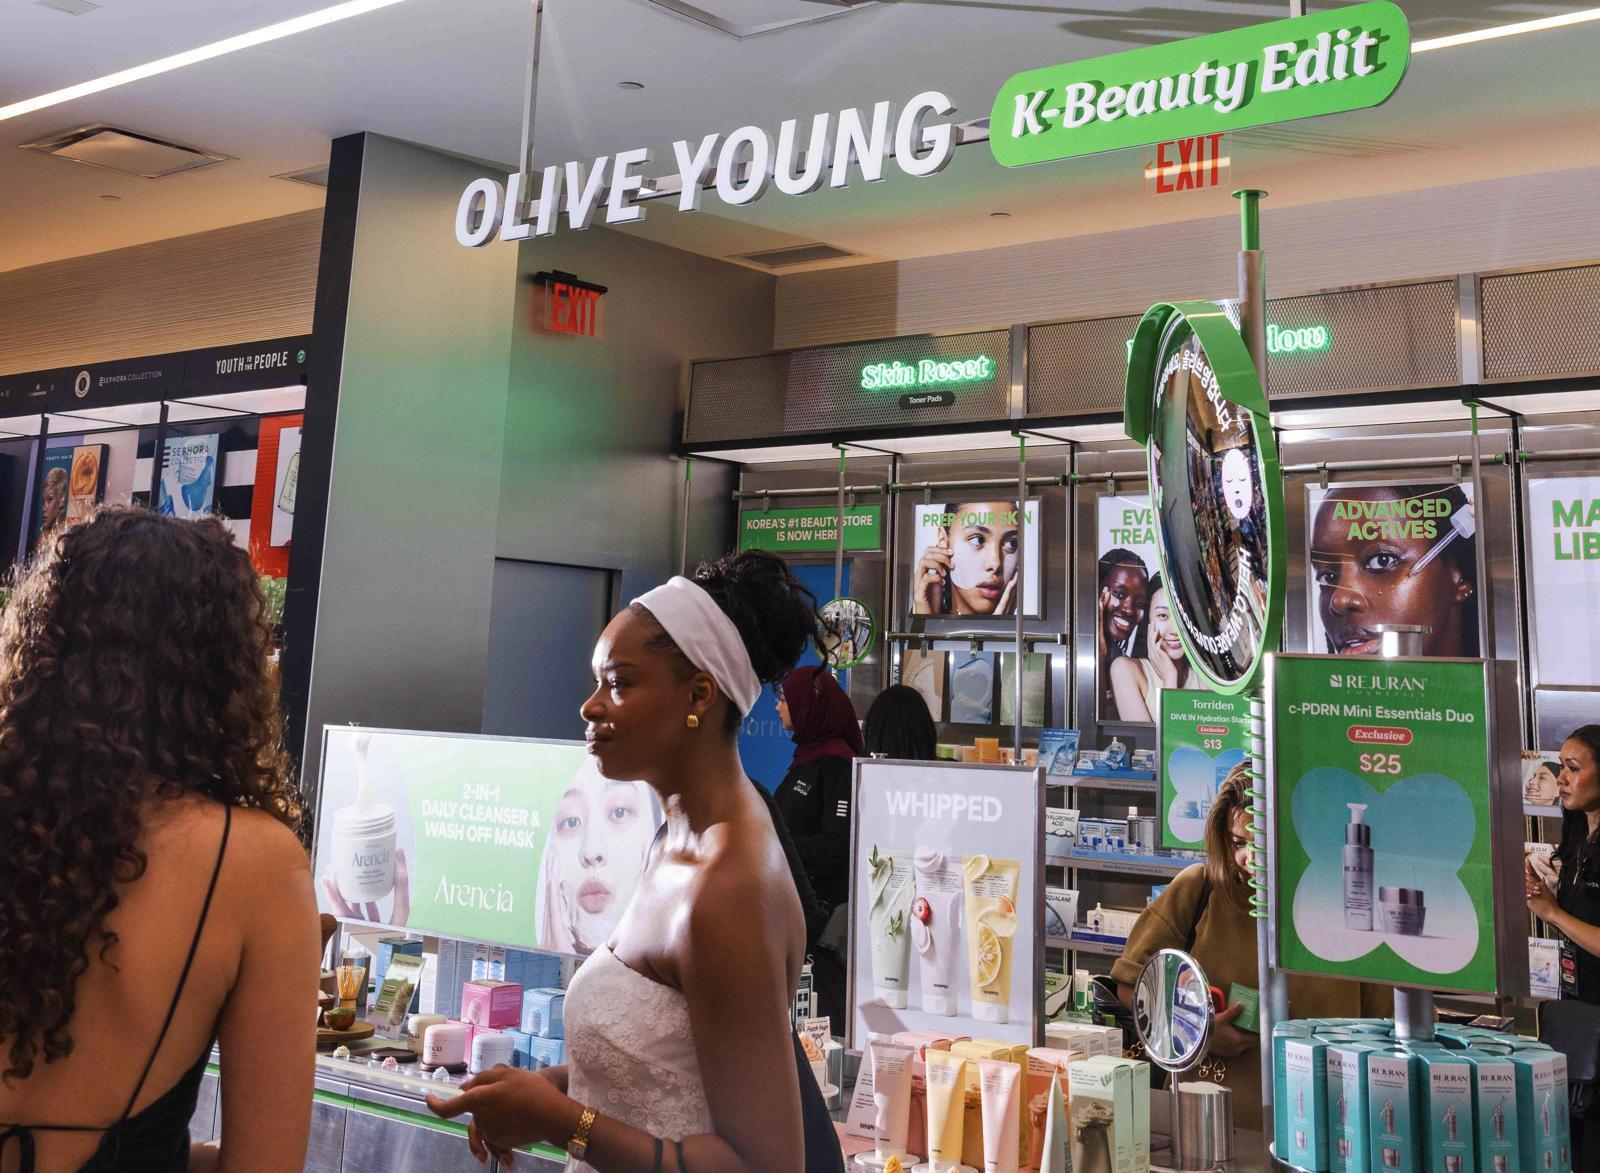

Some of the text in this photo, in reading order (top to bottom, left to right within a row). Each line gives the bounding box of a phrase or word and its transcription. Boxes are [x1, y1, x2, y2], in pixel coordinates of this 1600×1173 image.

[1011, 28, 1379, 138] K-Beauty Edit
[455, 90, 958, 248] OLIVE YOUNG
[1156, 133, 1225, 194] EXIT
[551, 282, 601, 337] EXIT
[1265, 323, 1327, 353] low
[216, 357, 245, 375] YOUTH
[253, 351, 288, 370] PEOPLE
[861, 354, 990, 388] Skin Reset
[103, 370, 162, 385] SEPHORA COLLECTION
[909, 394, 943, 404] Toner Pads
[172, 445, 209, 457] SEPHORA
[922, 510, 1032, 527] PREP YOUR SKN
[1123, 509, 1152, 525] EVE
[1332, 498, 1452, 521] ADVANCED
[1552, 499, 1600, 528] MA
[746, 518, 786, 530] KOREA'S
[787, 517, 799, 528] #1
[800, 516, 839, 528] BEAUTY
[1347, 520, 1438, 541] ACTIVES
[776, 529, 838, 542] IS NOW HERE
[1110, 528, 1155, 544] TREA
[1554, 532, 1600, 560] LIB
[1346, 674, 1428, 691] REJURAN
[1192, 699, 1234, 711] Torriden
[1288, 702, 1475, 723] c-PDRN Mini Essentials Duo
[1170, 713, 1186, 721] DIVE
[1197, 714, 1230, 724] Hydration
[1354, 729, 1406, 741] Exclusive
[1359, 752, 1402, 775] $25
[462, 783, 502, 802] 2-IN-1
[421, 799, 541, 828] DAILY CLEANSER &
[885, 789, 1003, 823] WHIPPED
[1045, 815, 1075, 823] YALURONIC
[424, 820, 535, 849] WASH OFF MASK
[433, 875, 514, 913] Arencia
